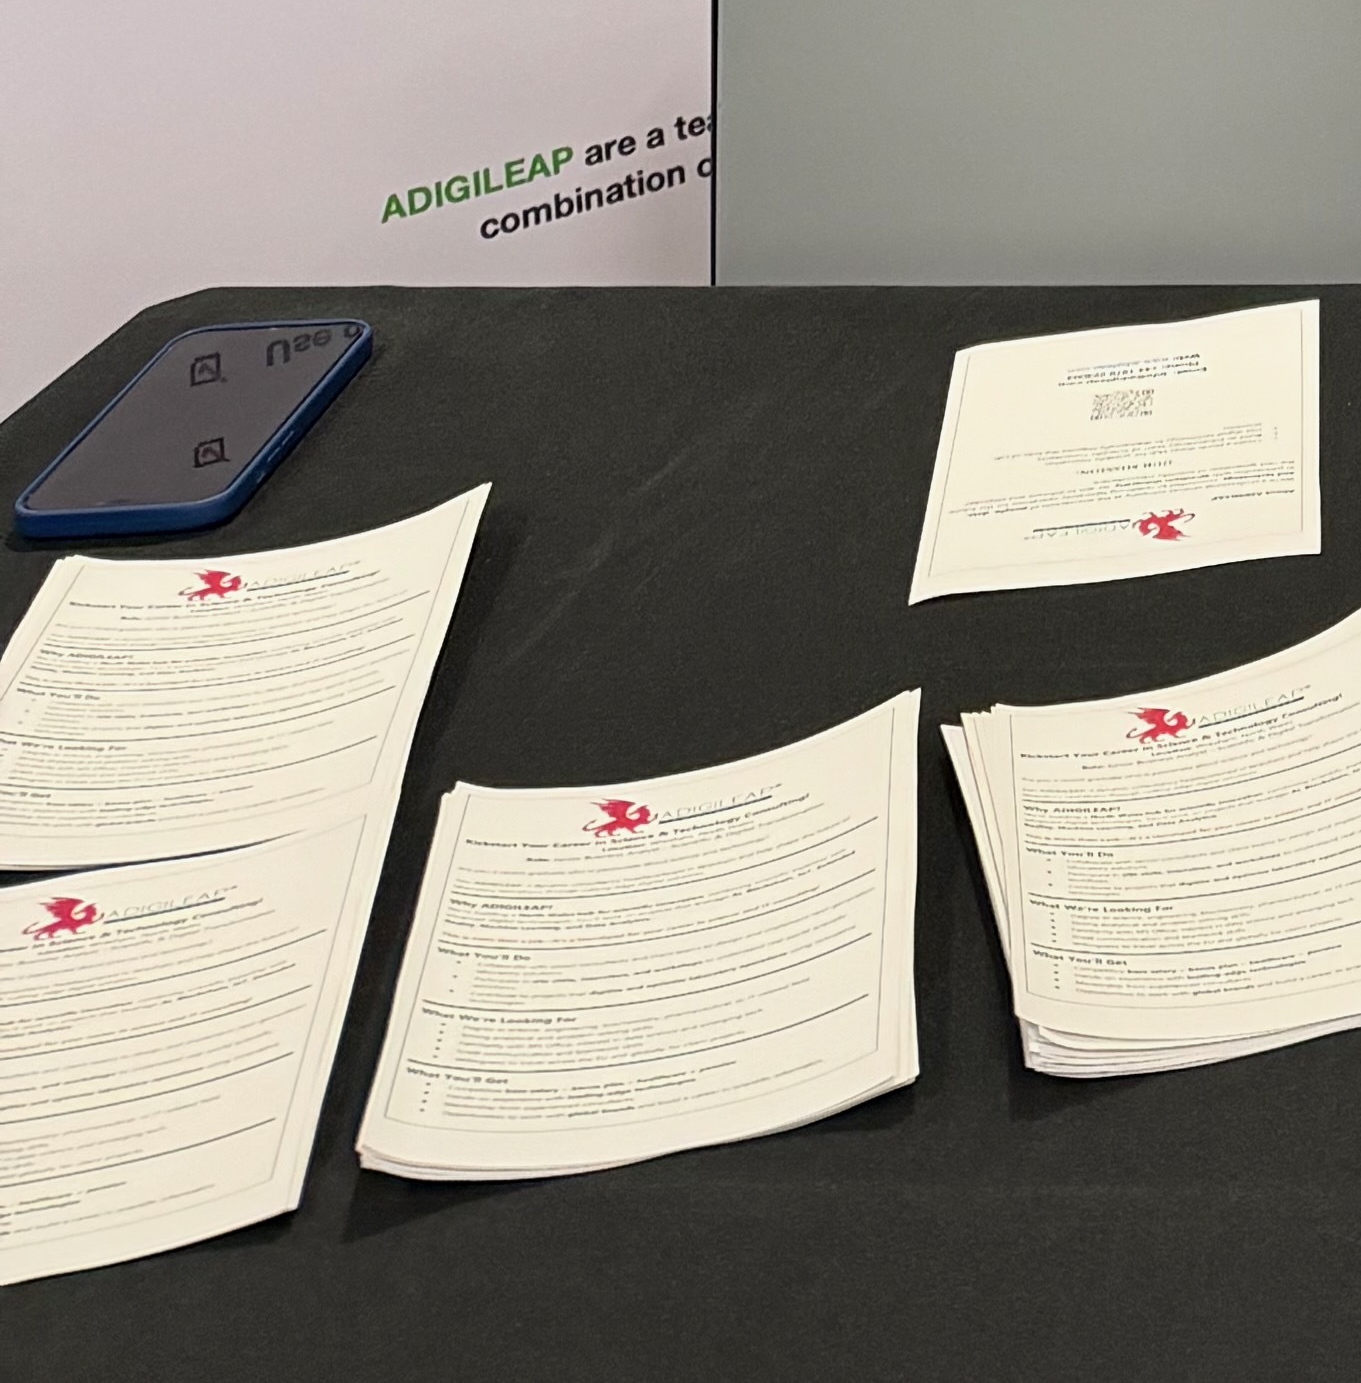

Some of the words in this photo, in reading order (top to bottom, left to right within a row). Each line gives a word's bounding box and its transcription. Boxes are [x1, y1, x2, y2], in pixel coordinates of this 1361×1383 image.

[380, 145, 575, 224] ADIGILEAP
[584, 135, 637, 167] are
[646, 127, 665, 149] a
[479, 163, 686, 240] combination
